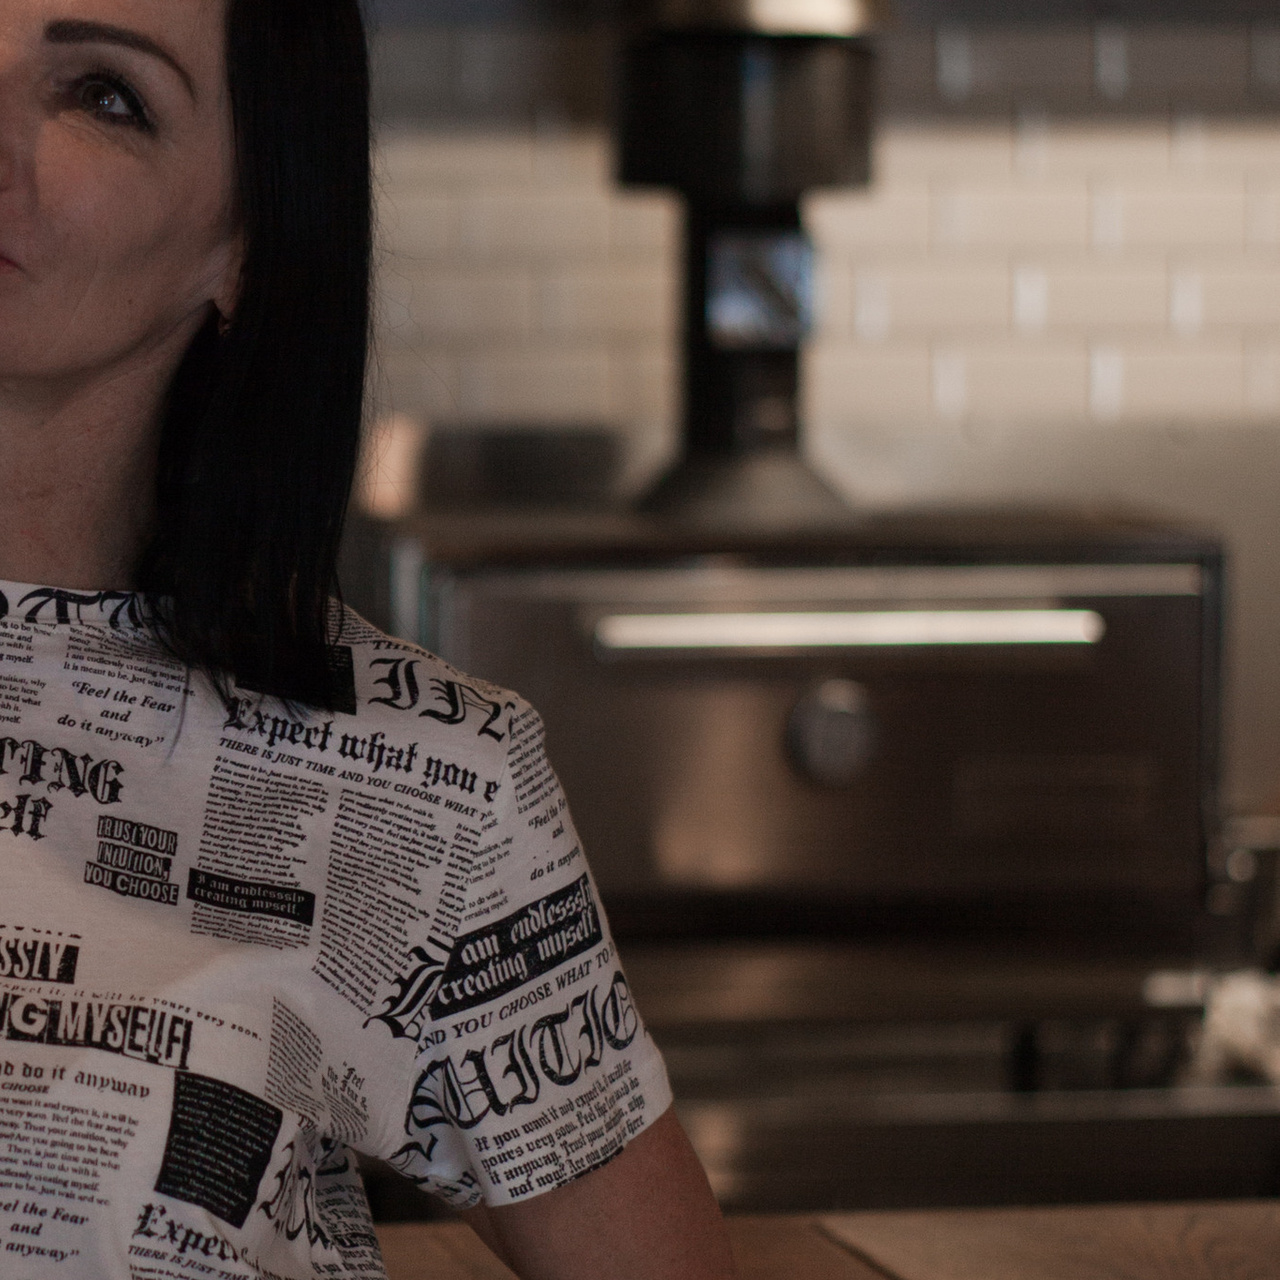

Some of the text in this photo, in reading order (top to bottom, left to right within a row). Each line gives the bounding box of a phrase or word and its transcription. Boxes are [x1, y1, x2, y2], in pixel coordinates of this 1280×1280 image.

[100, 709, 130, 722] and
[220, 738, 479, 818] THERE IS JUST TIME AND YOU CHOOSE WHAT
[339, 731, 418, 773] what
[423, 756, 477, 794] you
[140, 824, 177, 855] YOUR
[85, 862, 179, 905] YOU CHOOSE
[197, 872, 205, 884] I
[209, 880, 229, 892] am
[194, 887, 300, 916] creating myself.
[437, 913, 597, 1004] creating myself.
[461, 934, 500, 965] am
[452, 1011, 493, 1038] YOU
[499, 982, 553, 1020] CHOOSE
[555, 959, 593, 991] WHAT
[595, 947, 609, 968] TO
[2, 1081, 50, 1094] CHOOSE
[23, 1064, 44, 1078] do
[52, 1064, 64, 1080] it
[75, 1072, 150, 1098] anyway
[11, 1222, 42, 1235] and
